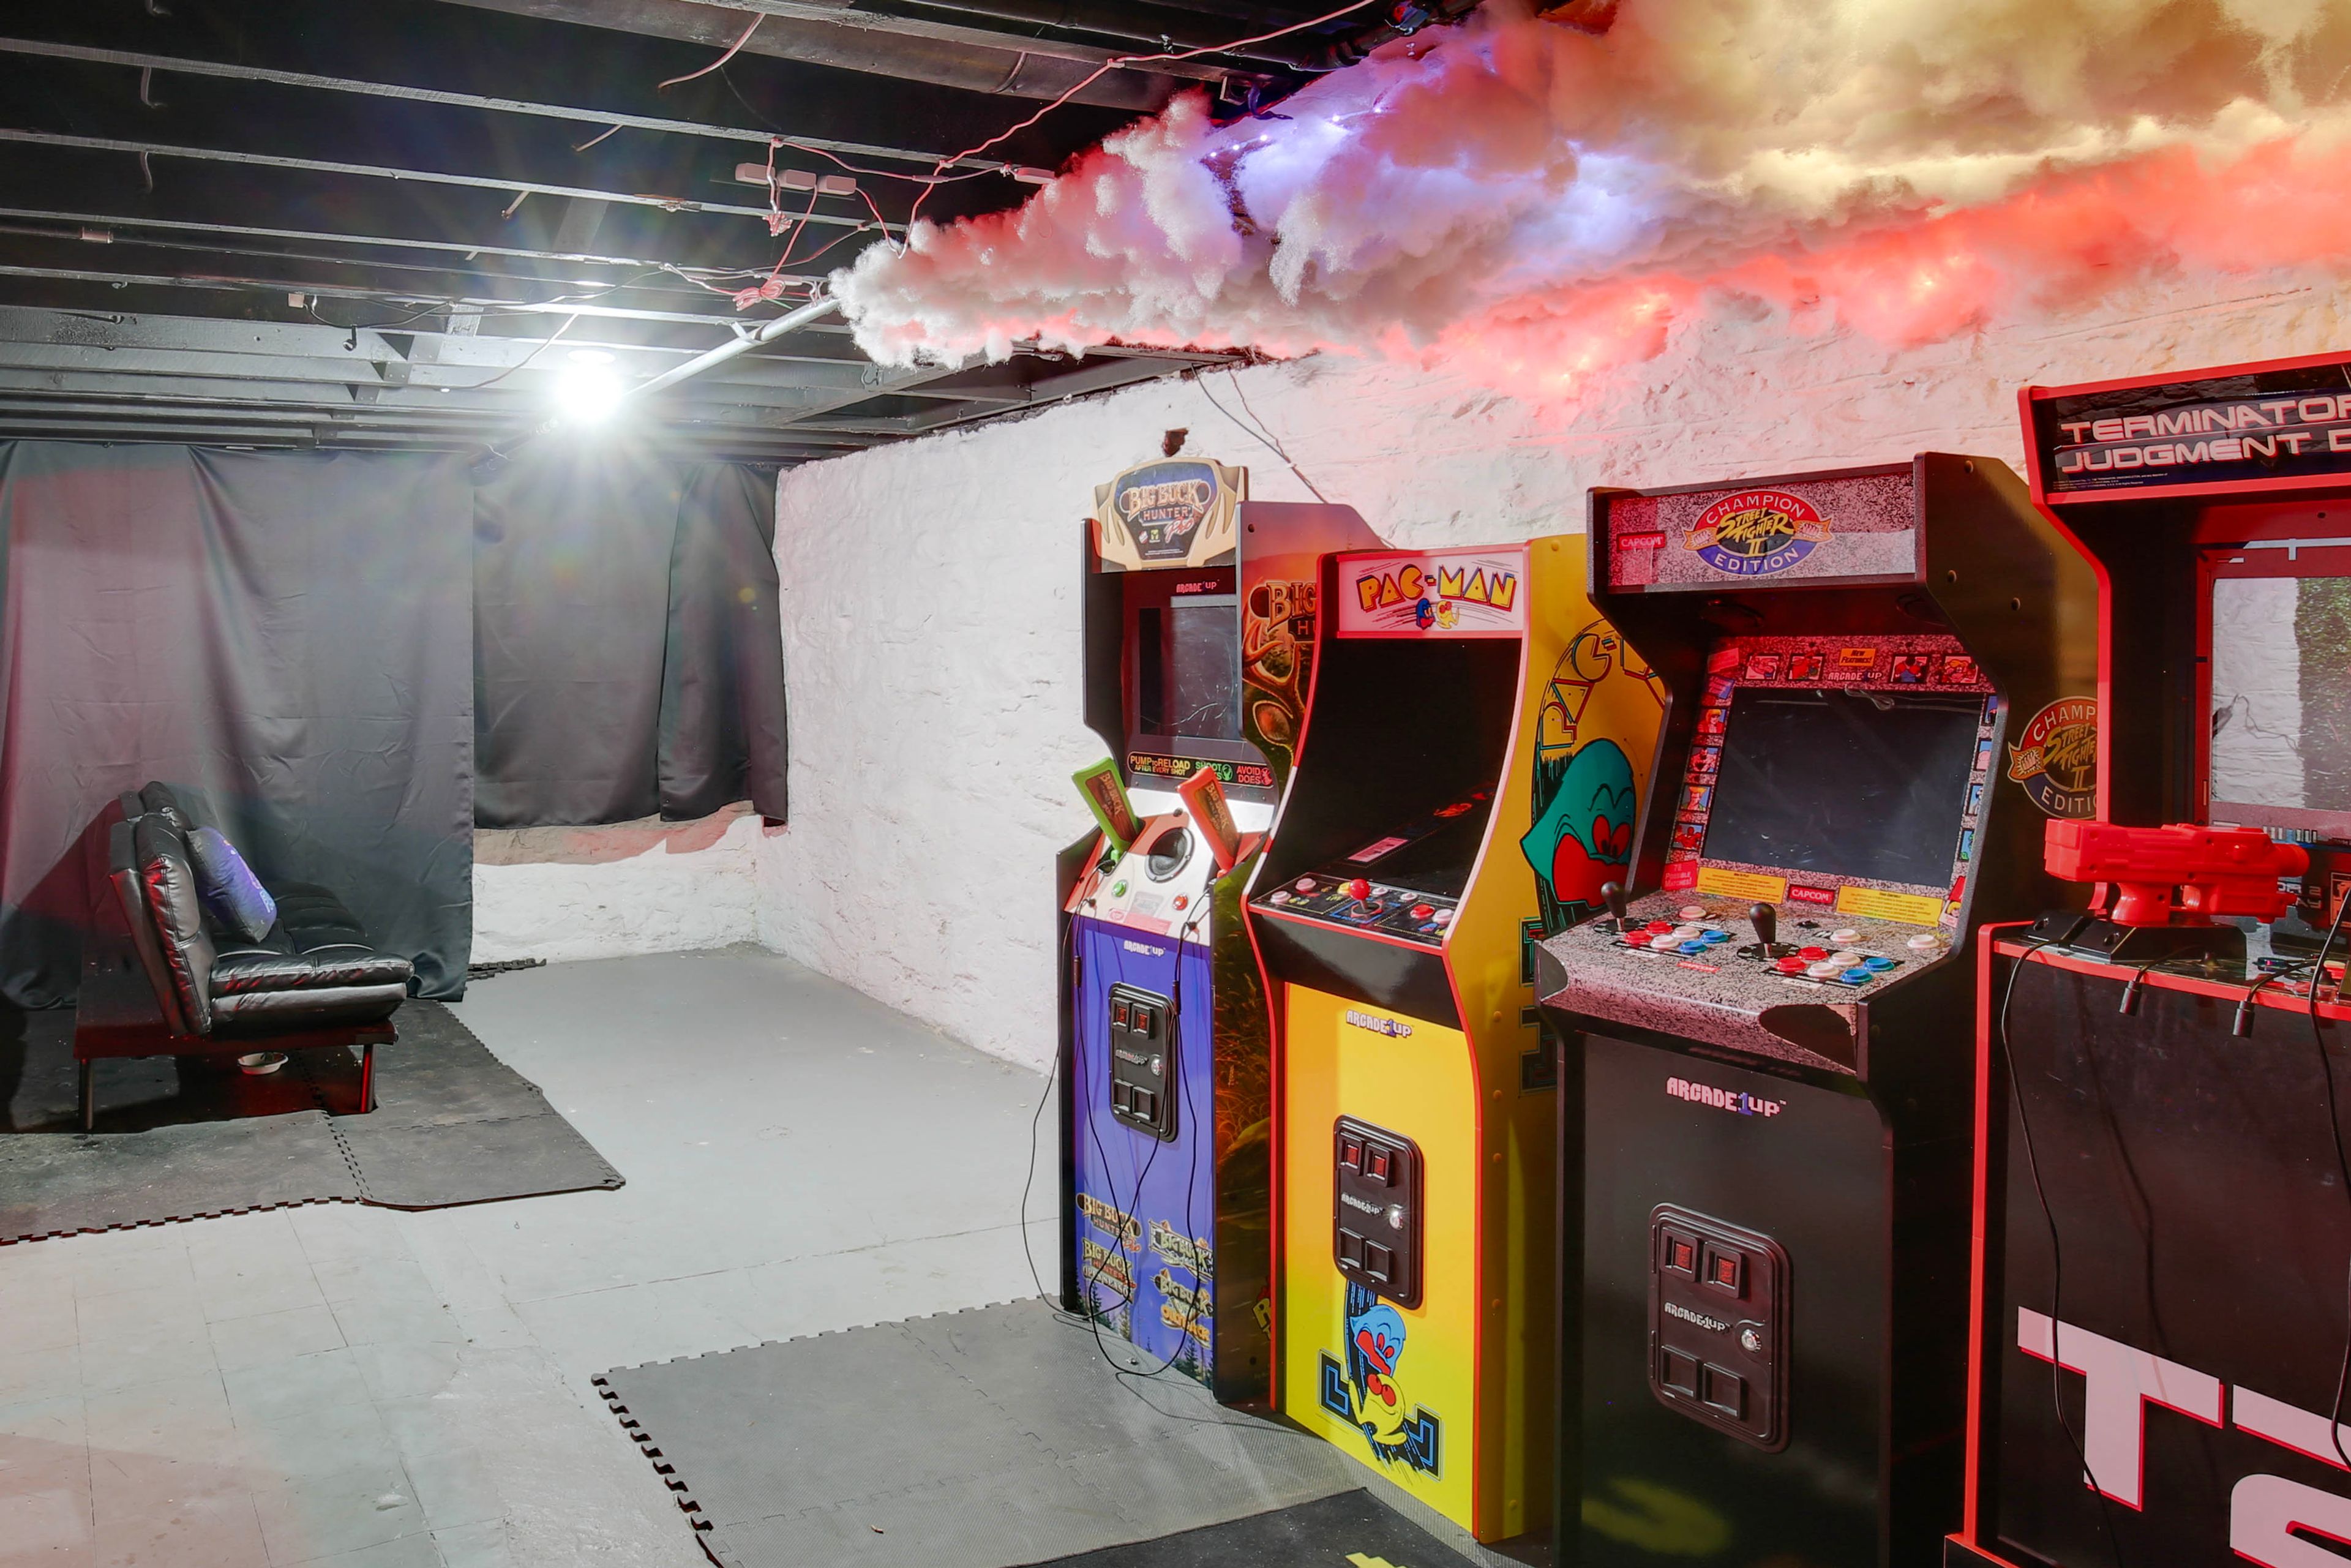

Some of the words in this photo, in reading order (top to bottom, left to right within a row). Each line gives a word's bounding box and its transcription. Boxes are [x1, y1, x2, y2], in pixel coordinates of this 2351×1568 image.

[2061, 430, 2312, 474] JUDGMENT
[1128, 487, 1157, 520] BIG
[1158, 480, 1204, 513] BUCK
[1143, 507, 1188, 520] HUNTER
[1706, 495, 1805, 523] CHAMPION
[1716, 508, 1768, 540] STREET
[1727, 513, 1794, 542] FIGHTER
[1622, 536, 1662, 547] CAPCOM
[1715, 548, 1799, 572] EDITION
[1356, 564, 1517, 612] PAC-MAN
[1266, 582, 1316, 632] BIG
[2033, 705, 2096, 741] CHAMP
[2042, 723, 2090, 765] STREET
[2053, 733, 2096, 770] FIGHTE
[1130, 756, 1152, 765] PUMP
[1158, 759, 1190, 770] RELOAD
[1236, 766, 1261, 775] AVOID
[1238, 775, 1261, 784] DOES
[2041, 786, 2096, 812] EDITI
[1791, 889, 1830, 901] CAPCOM
[1083, 1195, 1102, 1216] BIG
[1084, 1240, 1102, 1260] BIG
